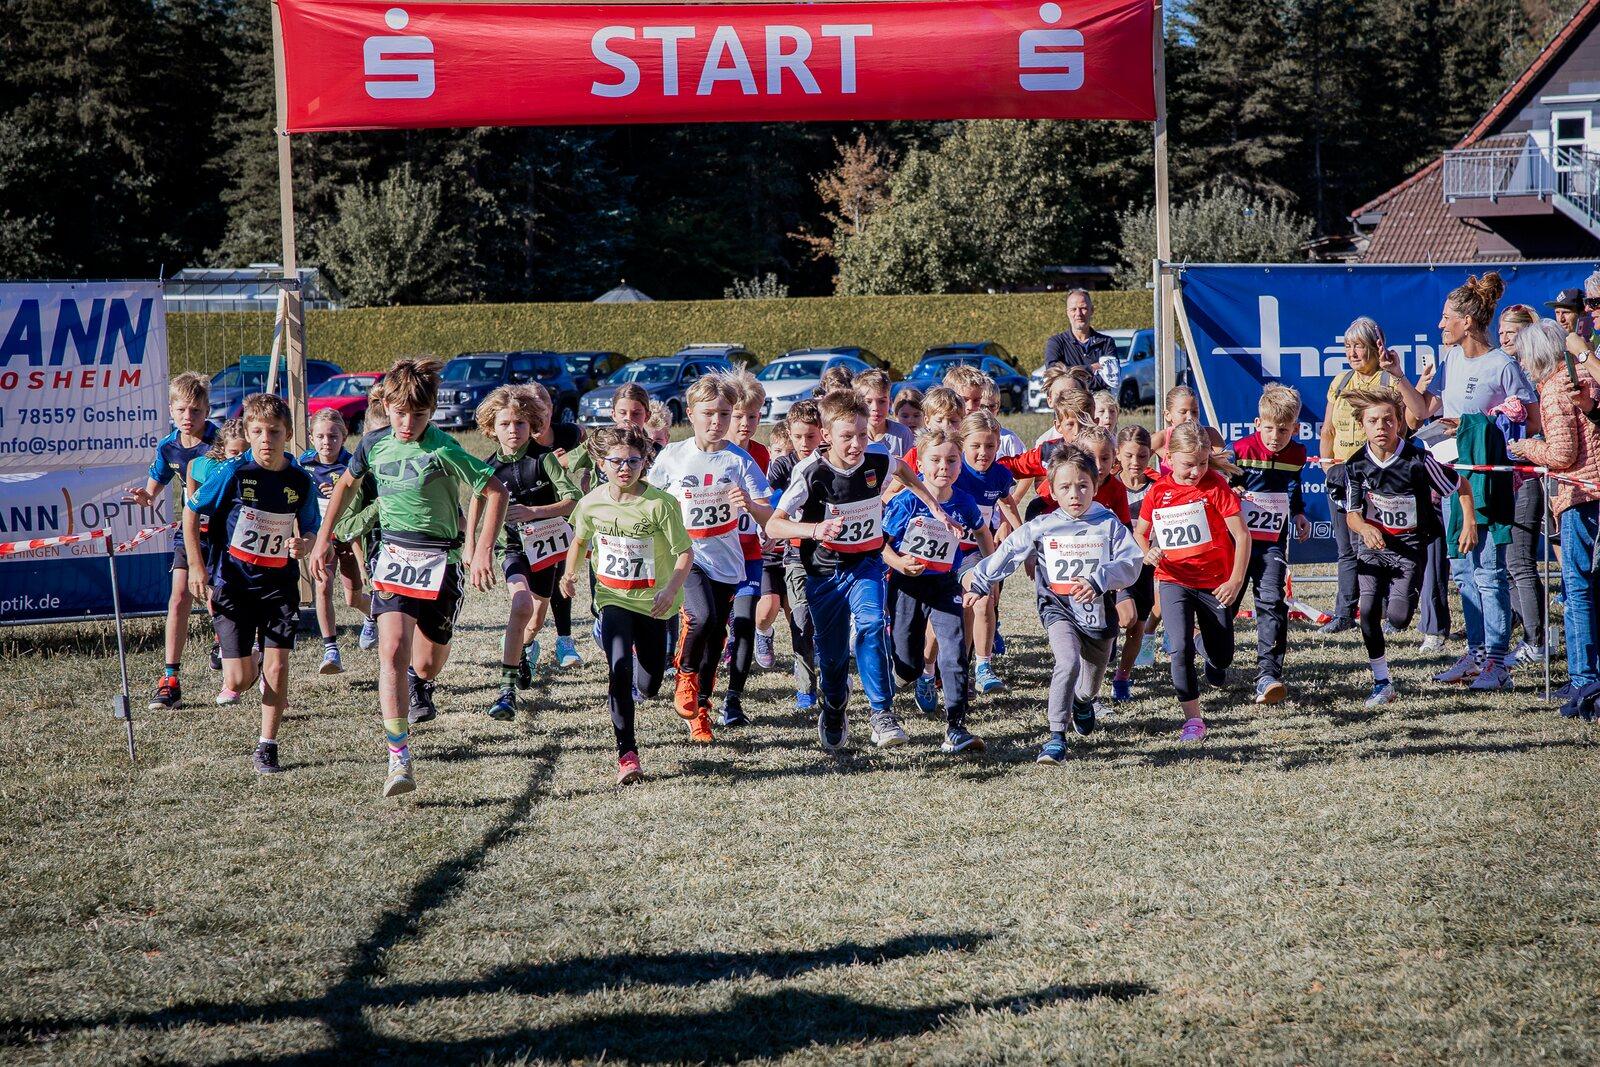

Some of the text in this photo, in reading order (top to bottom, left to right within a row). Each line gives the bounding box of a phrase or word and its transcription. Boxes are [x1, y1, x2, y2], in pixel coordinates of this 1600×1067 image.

[591, 24, 873, 97] START
[18, 406, 158, 425] 78559 Gosheim
[242, 478, 258, 486] JAKO
[80, 499, 166, 529] OPTIK
[690, 503, 731, 527] 233
[1247, 510, 1283, 531] 225
[834, 518, 875, 542] 232
[1162, 524, 1202, 547] 220
[240, 530, 283, 555] 213
[532, 531, 570, 559] 211
[909, 535, 950, 560] 234
[1060, 550, 1090, 558] Tuttlingen
[383, 562, 432, 588] 204
[605, 554, 644, 578] 237
[1054, 558, 1100, 581] 227
[0, 593, 60, 614] ptik.de
